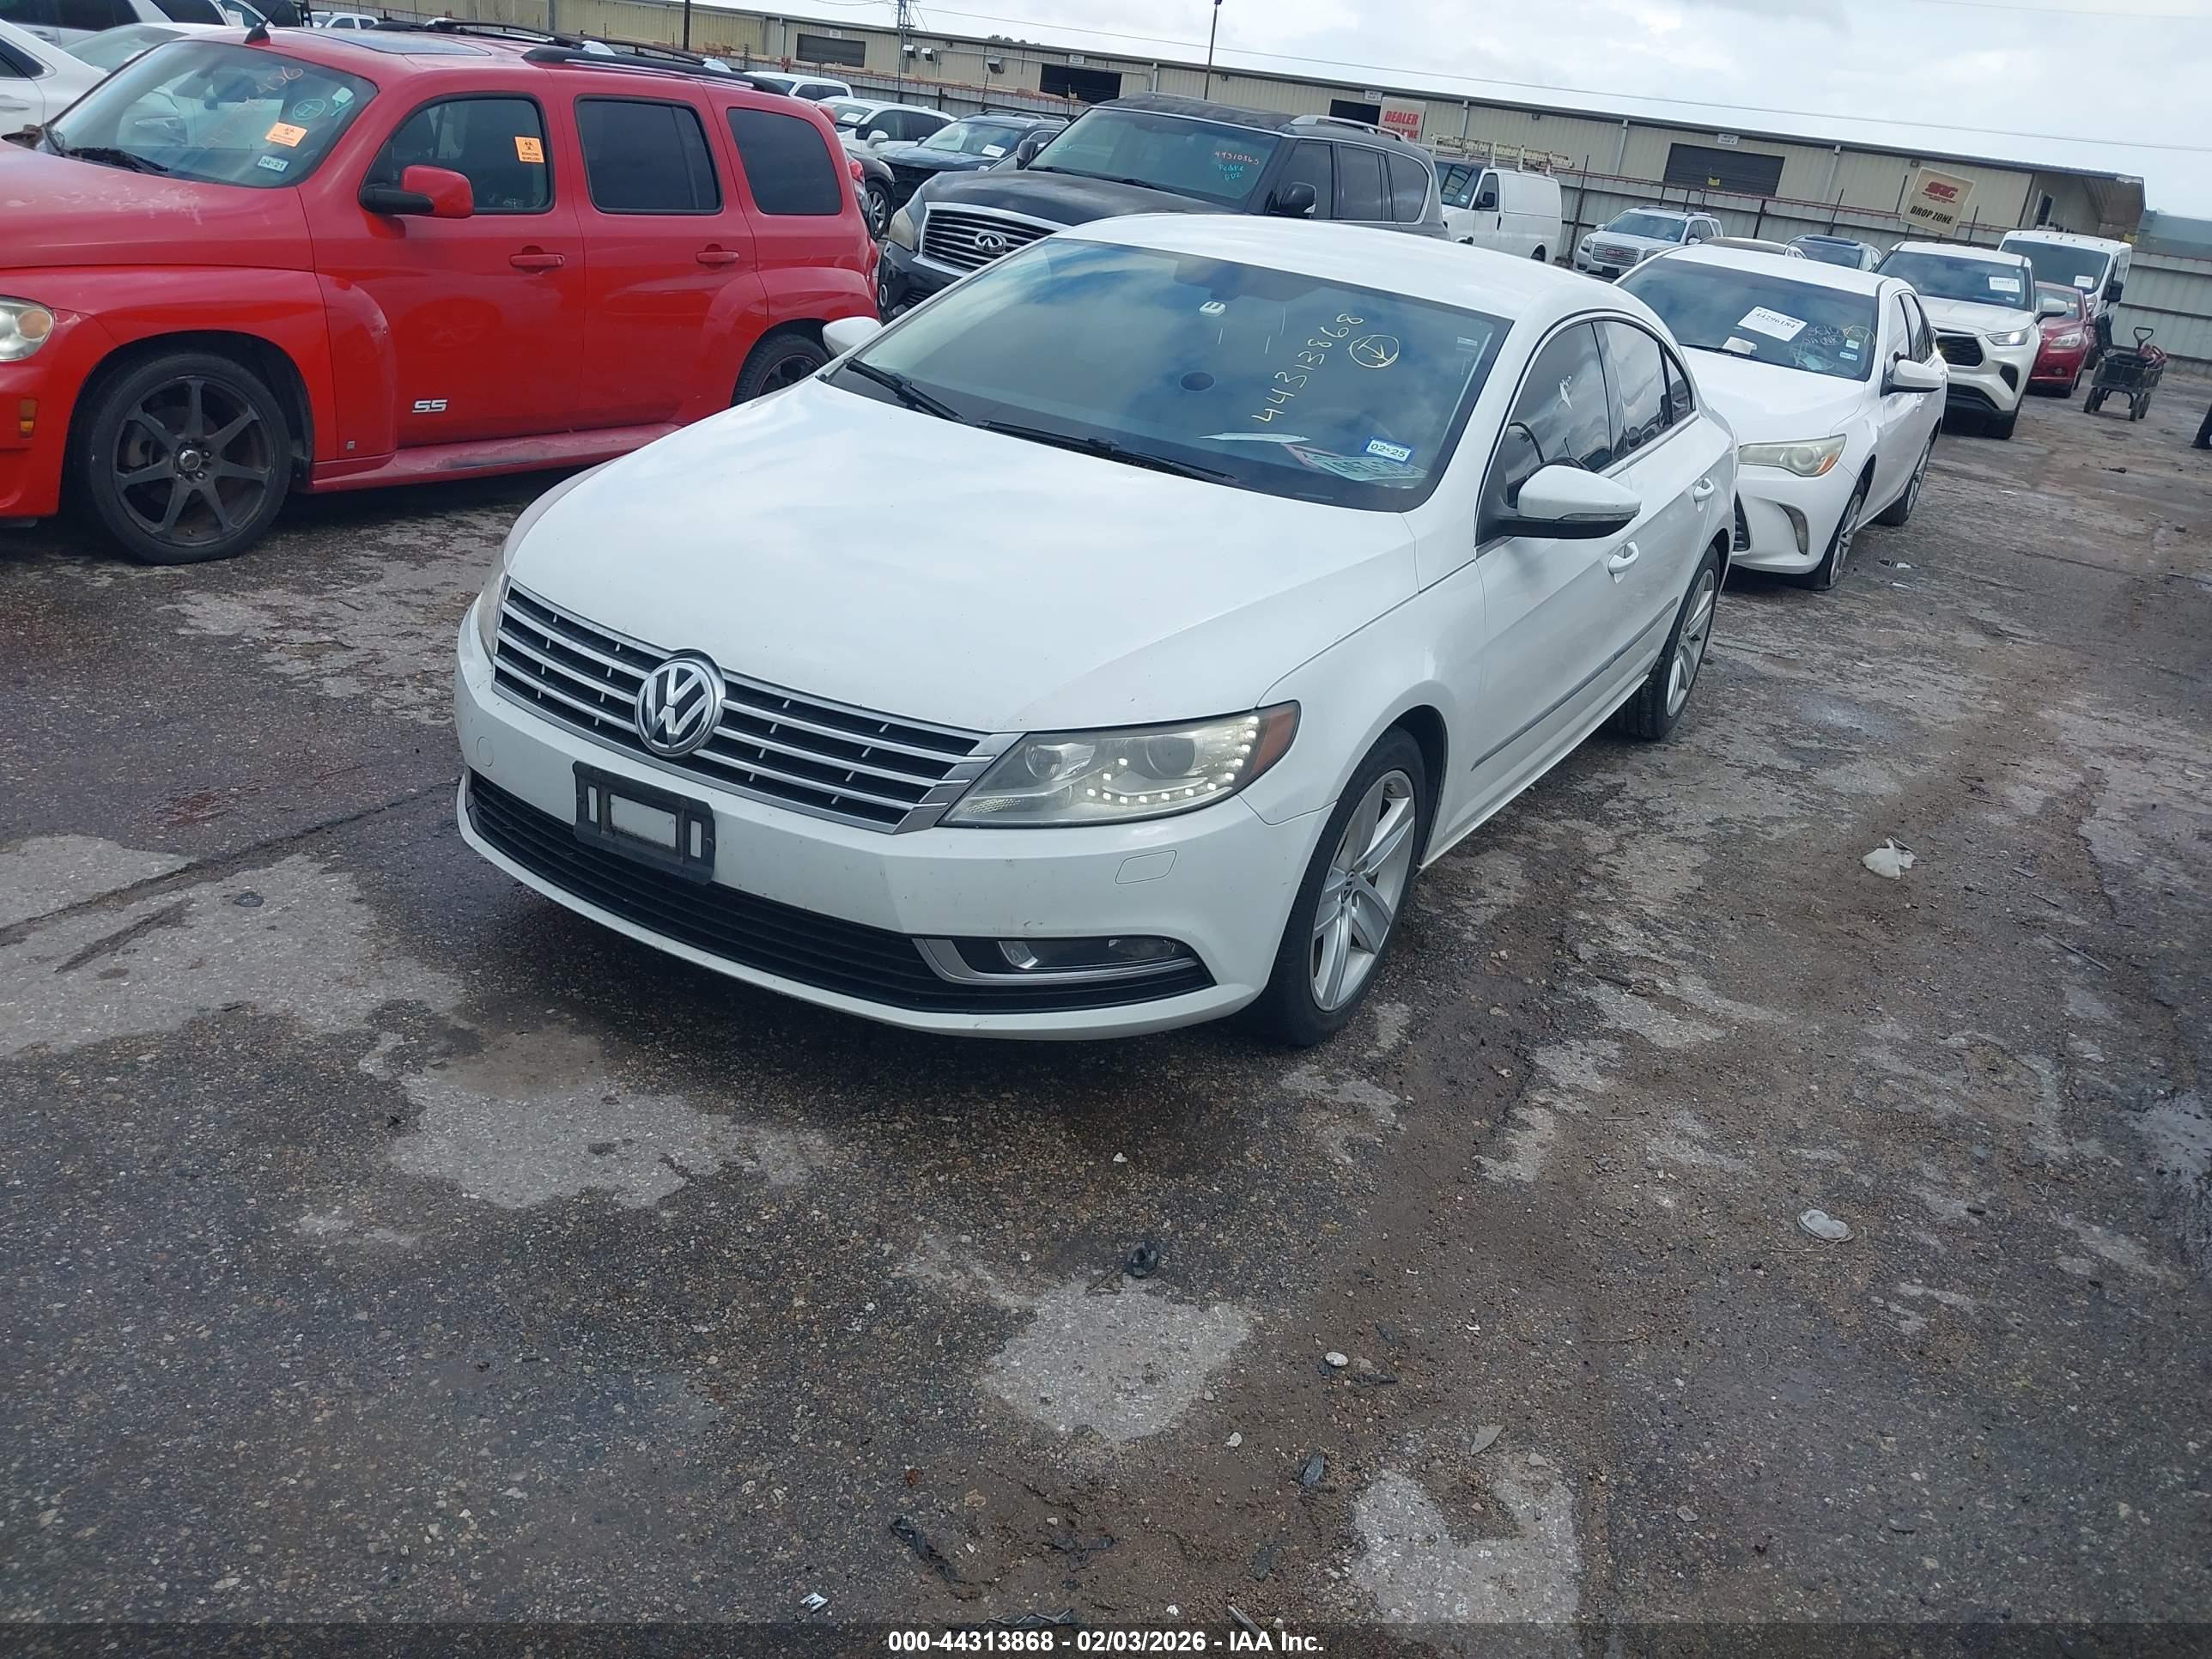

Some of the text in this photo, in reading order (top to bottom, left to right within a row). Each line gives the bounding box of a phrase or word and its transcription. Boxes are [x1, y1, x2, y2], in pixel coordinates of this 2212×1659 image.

[1383, 111, 1419, 125] DEALER
[1909, 205, 1954, 225] DROP ZONE
[1250, 313, 1364, 422] 44313868
[412, 398, 448, 413] SS
